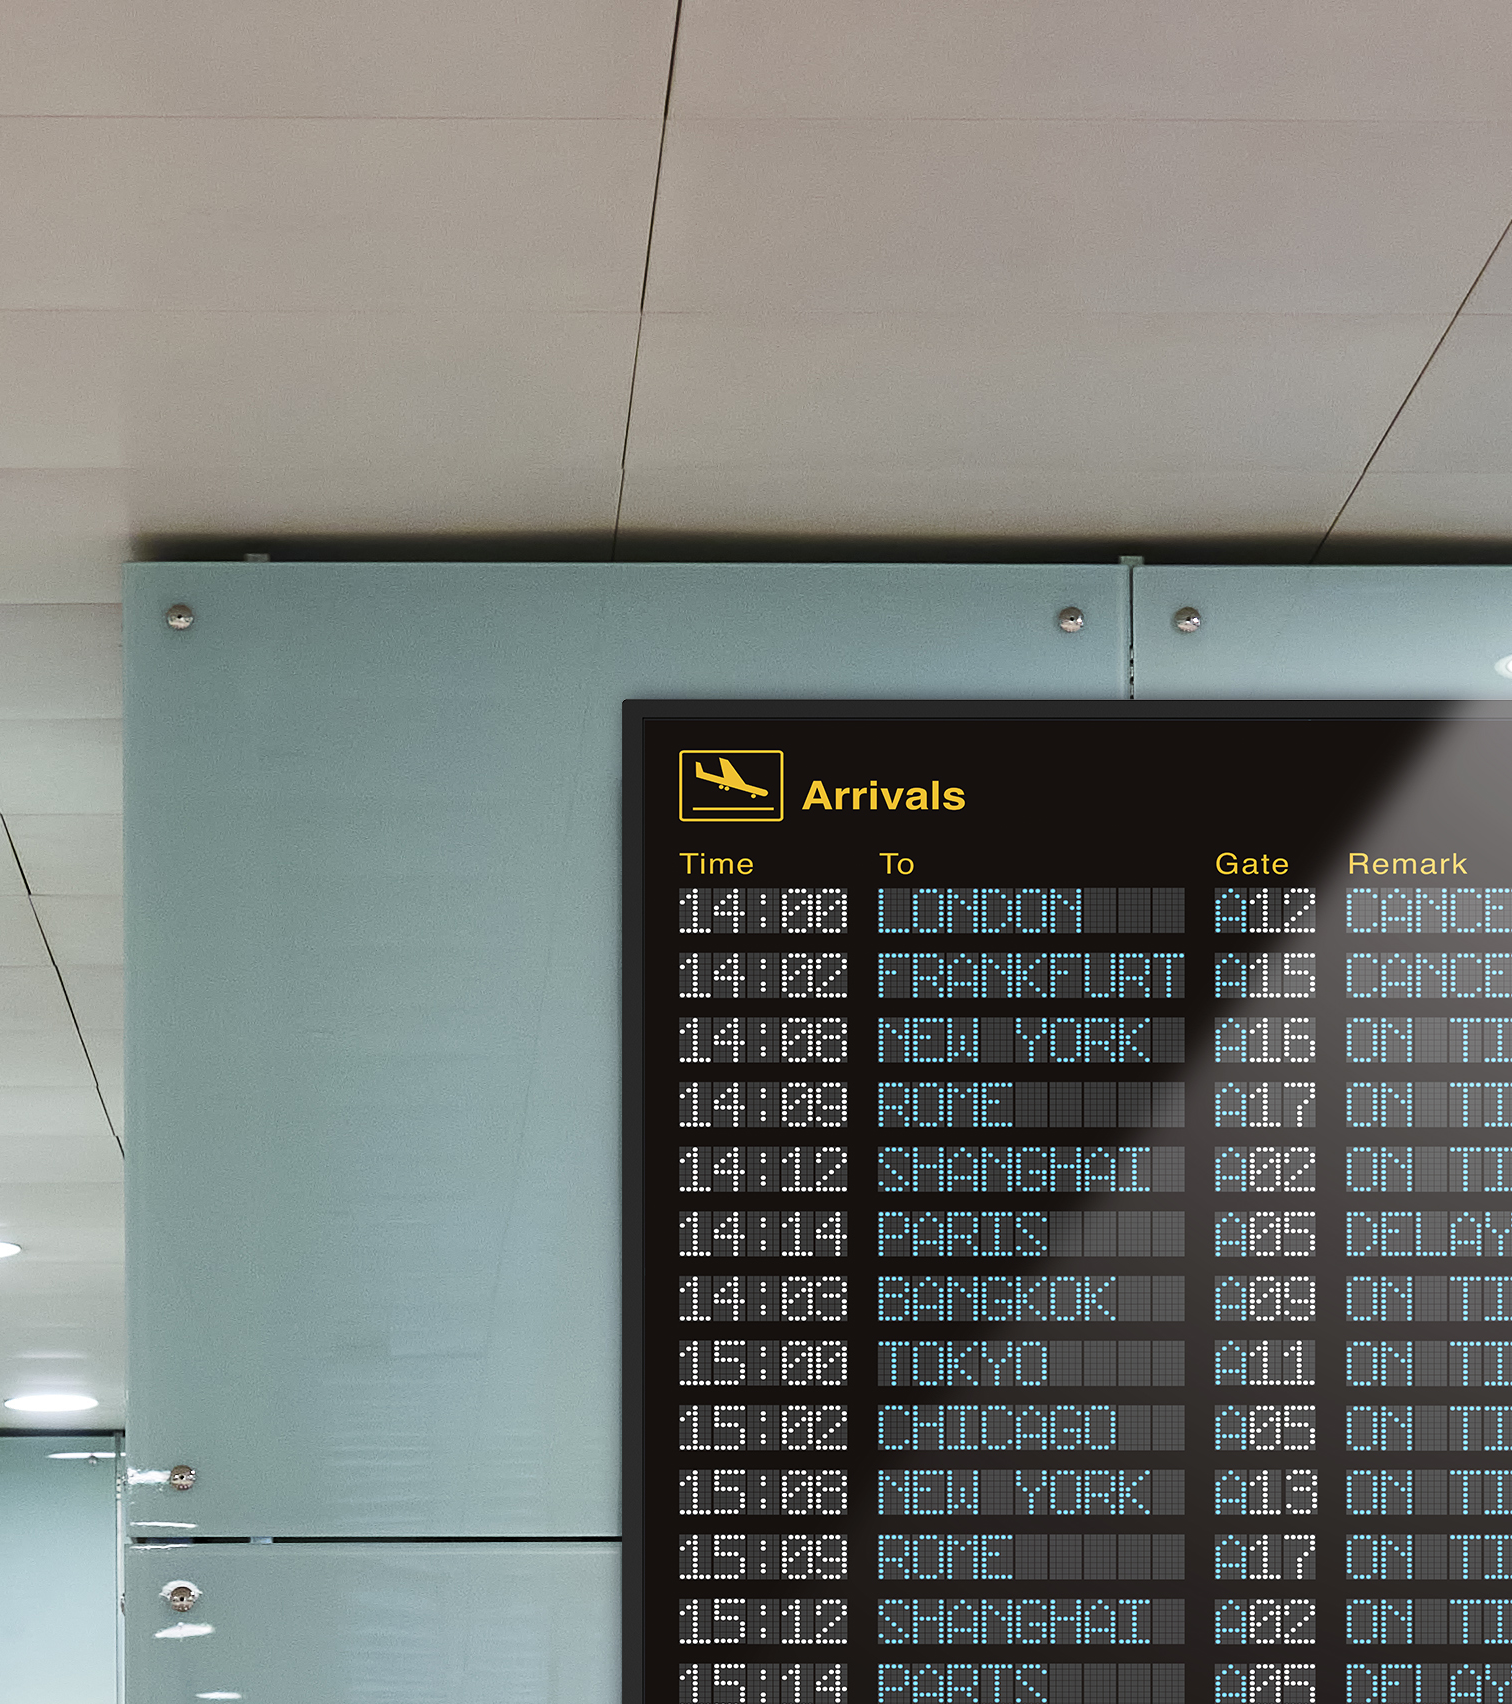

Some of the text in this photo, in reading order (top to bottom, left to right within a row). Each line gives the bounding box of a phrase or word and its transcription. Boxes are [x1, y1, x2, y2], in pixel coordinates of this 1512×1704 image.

[802, 780, 965, 810] Arrivals
[679, 852, 1467, 875] Time To Gate Remark
[680, 889, 847, 933] 14:00
[879, 889, 1081, 933] LONDON
[1216, 889, 1315, 932] A12
[680, 1018, 847, 1062] 14:08
[879, 1018, 978, 1062] NEW
[1016, 1018, 1150, 1062] YORK
[1216, 1018, 1315, 1062] A16
[1347, 1018, 1412, 1062] ON
[680, 1147, 847, 1191] 14:12
[879, 1147, 1150, 1191] SHANGHAI
[1216, 1147, 1315, 1191] A02
[1347, 1147, 1412, 1191] ON
[680, 1277, 847, 1321] 14:03
[879, 1277, 1115, 1321] BANGKOK
[1216, 1277, 1315, 1321] A09
[1347, 1277, 1412, 1321] ON
[680, 1406, 847, 1450] 15:02
[879, 1406, 1115, 1449] CHICAGO
[1216, 1406, 1315, 1450] A05
[1347, 1406, 1412, 1450] ON
[680, 1470, 847, 1514] 15:08
[879, 1470, 978, 1514] NEW
[1016, 1470, 1150, 1514] YORK
[1216, 1470, 1317, 1514] A13
[1347, 1470, 1412, 1514] ON
[680, 1535, 847, 1579] 15:09
[879, 1535, 1012, 1579] ROME
[1216, 1535, 1315, 1579] A17
[1347, 1535, 1412, 1579] ON
